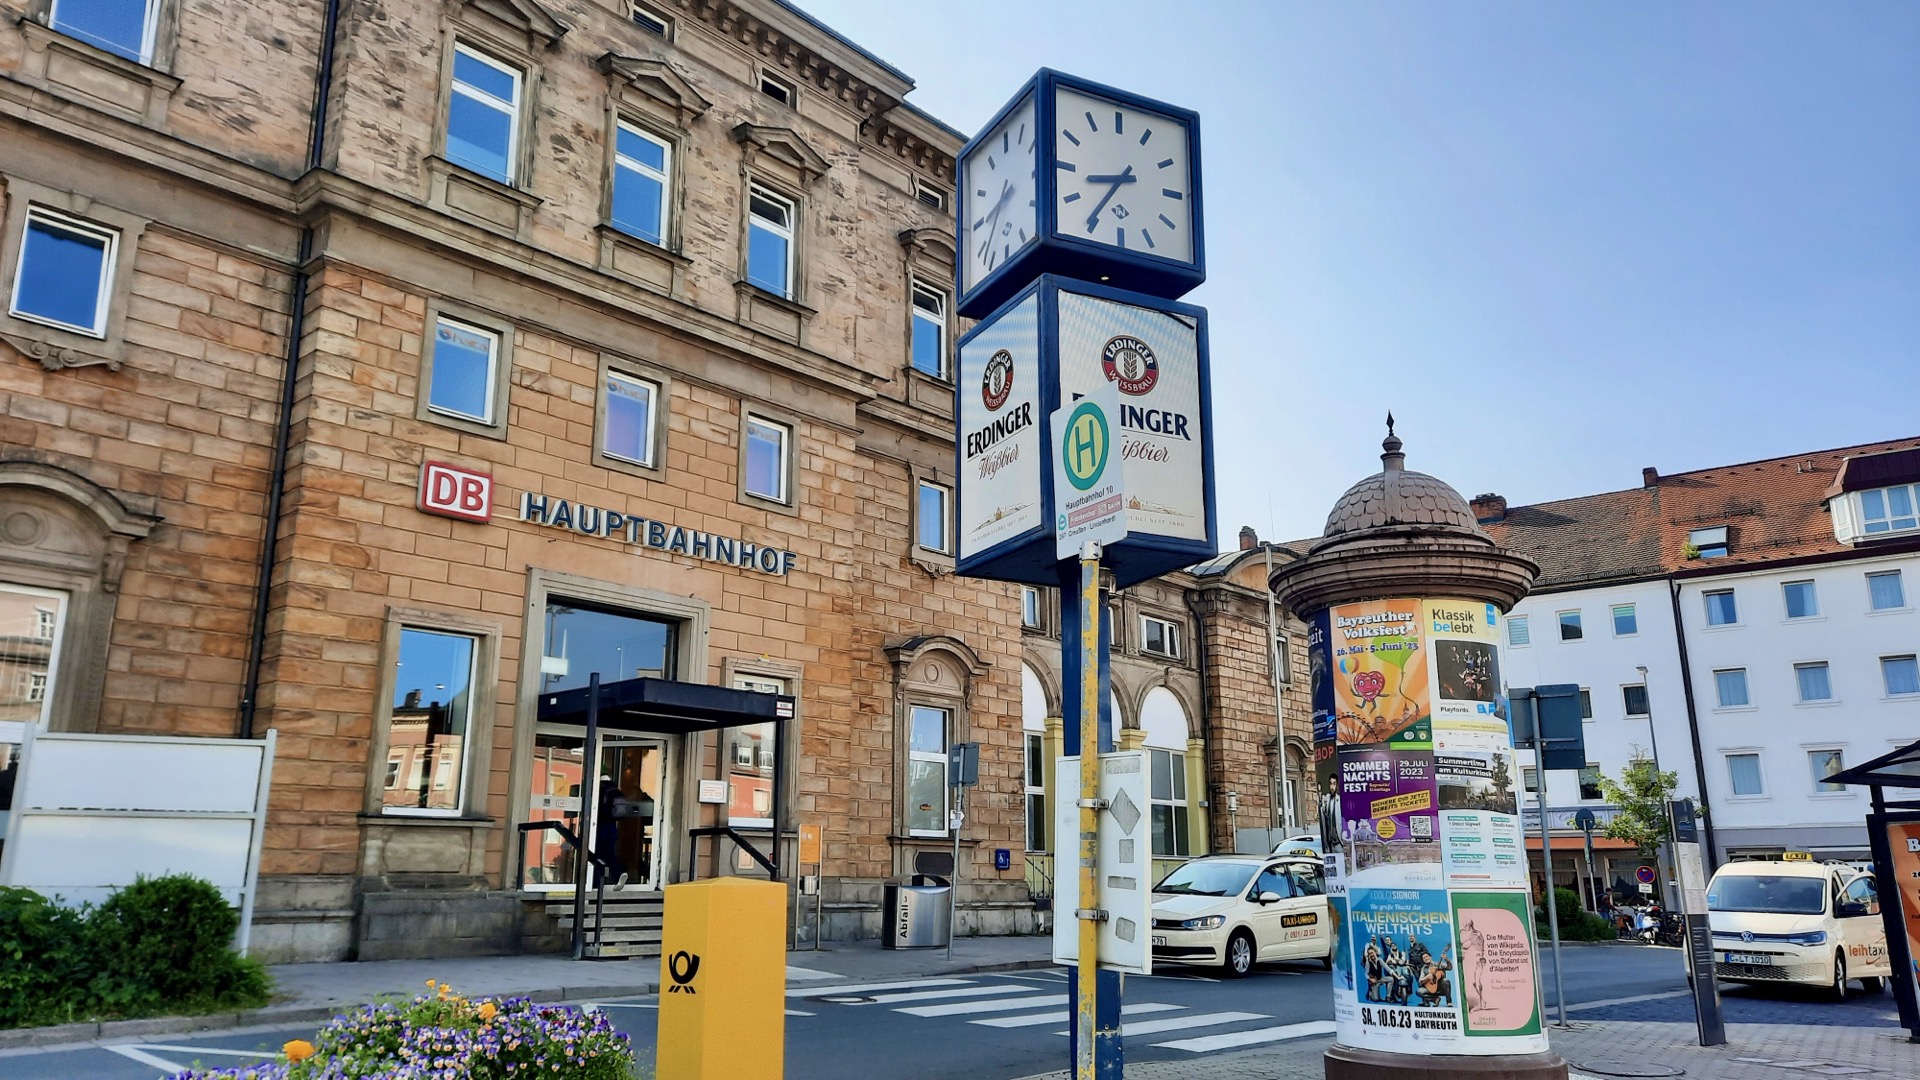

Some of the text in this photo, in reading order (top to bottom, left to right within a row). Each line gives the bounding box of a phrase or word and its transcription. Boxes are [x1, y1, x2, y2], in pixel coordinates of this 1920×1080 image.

[1105, 338, 1154, 365] ERDINGER
[984, 353, 1011, 384] ERDINGER
[967, 401, 1033, 459] ERDINGER
[978, 443, 1020, 480] Weißbier
[431, 470, 484, 511] DB
[1065, 488, 1105, 510] Hauptbahnhof
[520, 492, 797, 576] HAUPTBAHNHOF
[1336, 611, 1414, 628] Bayreuther
[1432, 609, 1475, 622] Klassik
[1343, 625, 1406, 639] Volksfest
[1336, 648, 1348, 656] 26.
[1348, 645, 1364, 655] Mai
[1369, 644, 1379, 653] 5.
[1380, 642, 1402, 651] Juni
[1342, 760, 1390, 772] SOMMER
[1438, 757, 1486, 768] Summertime
[1343, 771, 1391, 782] NACHTS
[1399, 768, 1423, 776] 2023
[1453, 767, 1493, 778] Kulturkiosk
[1343, 782, 1368, 792] FEST
[1392, 890, 1420, 900] SIGNORI
[900, 904, 908, 938] Abfall
[1283, 915, 1316, 926] TAXI-UNION
[1352, 911, 1450, 924] ITALIENISCHEN
[1365, 923, 1433, 935] WELTHITS
[1729, 954, 1769, 964] C LT 1010
[1377, 1008, 1412, 1028] 10.6.23
[1414, 1011, 1456, 1019] KULTURKIOSK
[1414, 1019, 1458, 1030] BAYREUTH
